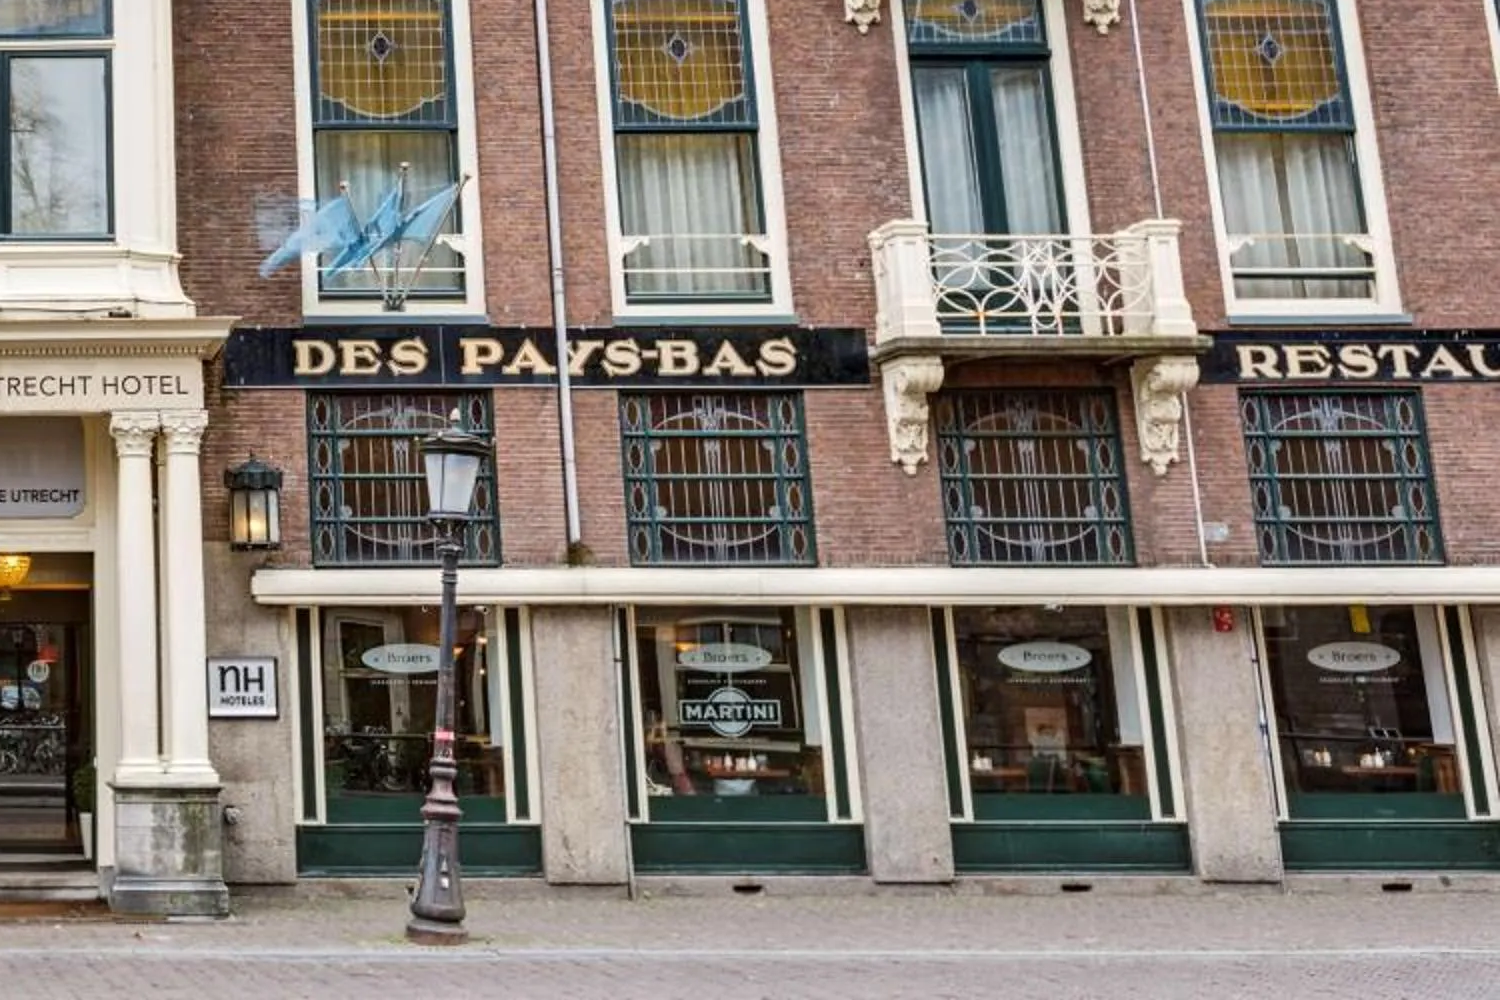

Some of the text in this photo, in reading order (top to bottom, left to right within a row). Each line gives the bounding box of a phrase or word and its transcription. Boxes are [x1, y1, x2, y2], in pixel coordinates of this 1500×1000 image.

[292, 336, 798, 377] DES PAYS-BAS
[1235, 343, 1500, 379] RESTAU
[102, 374, 189, 396] HOTEL
[11, 489, 81, 503] UTRECHT
[684, 704, 775, 720] MARTINI
